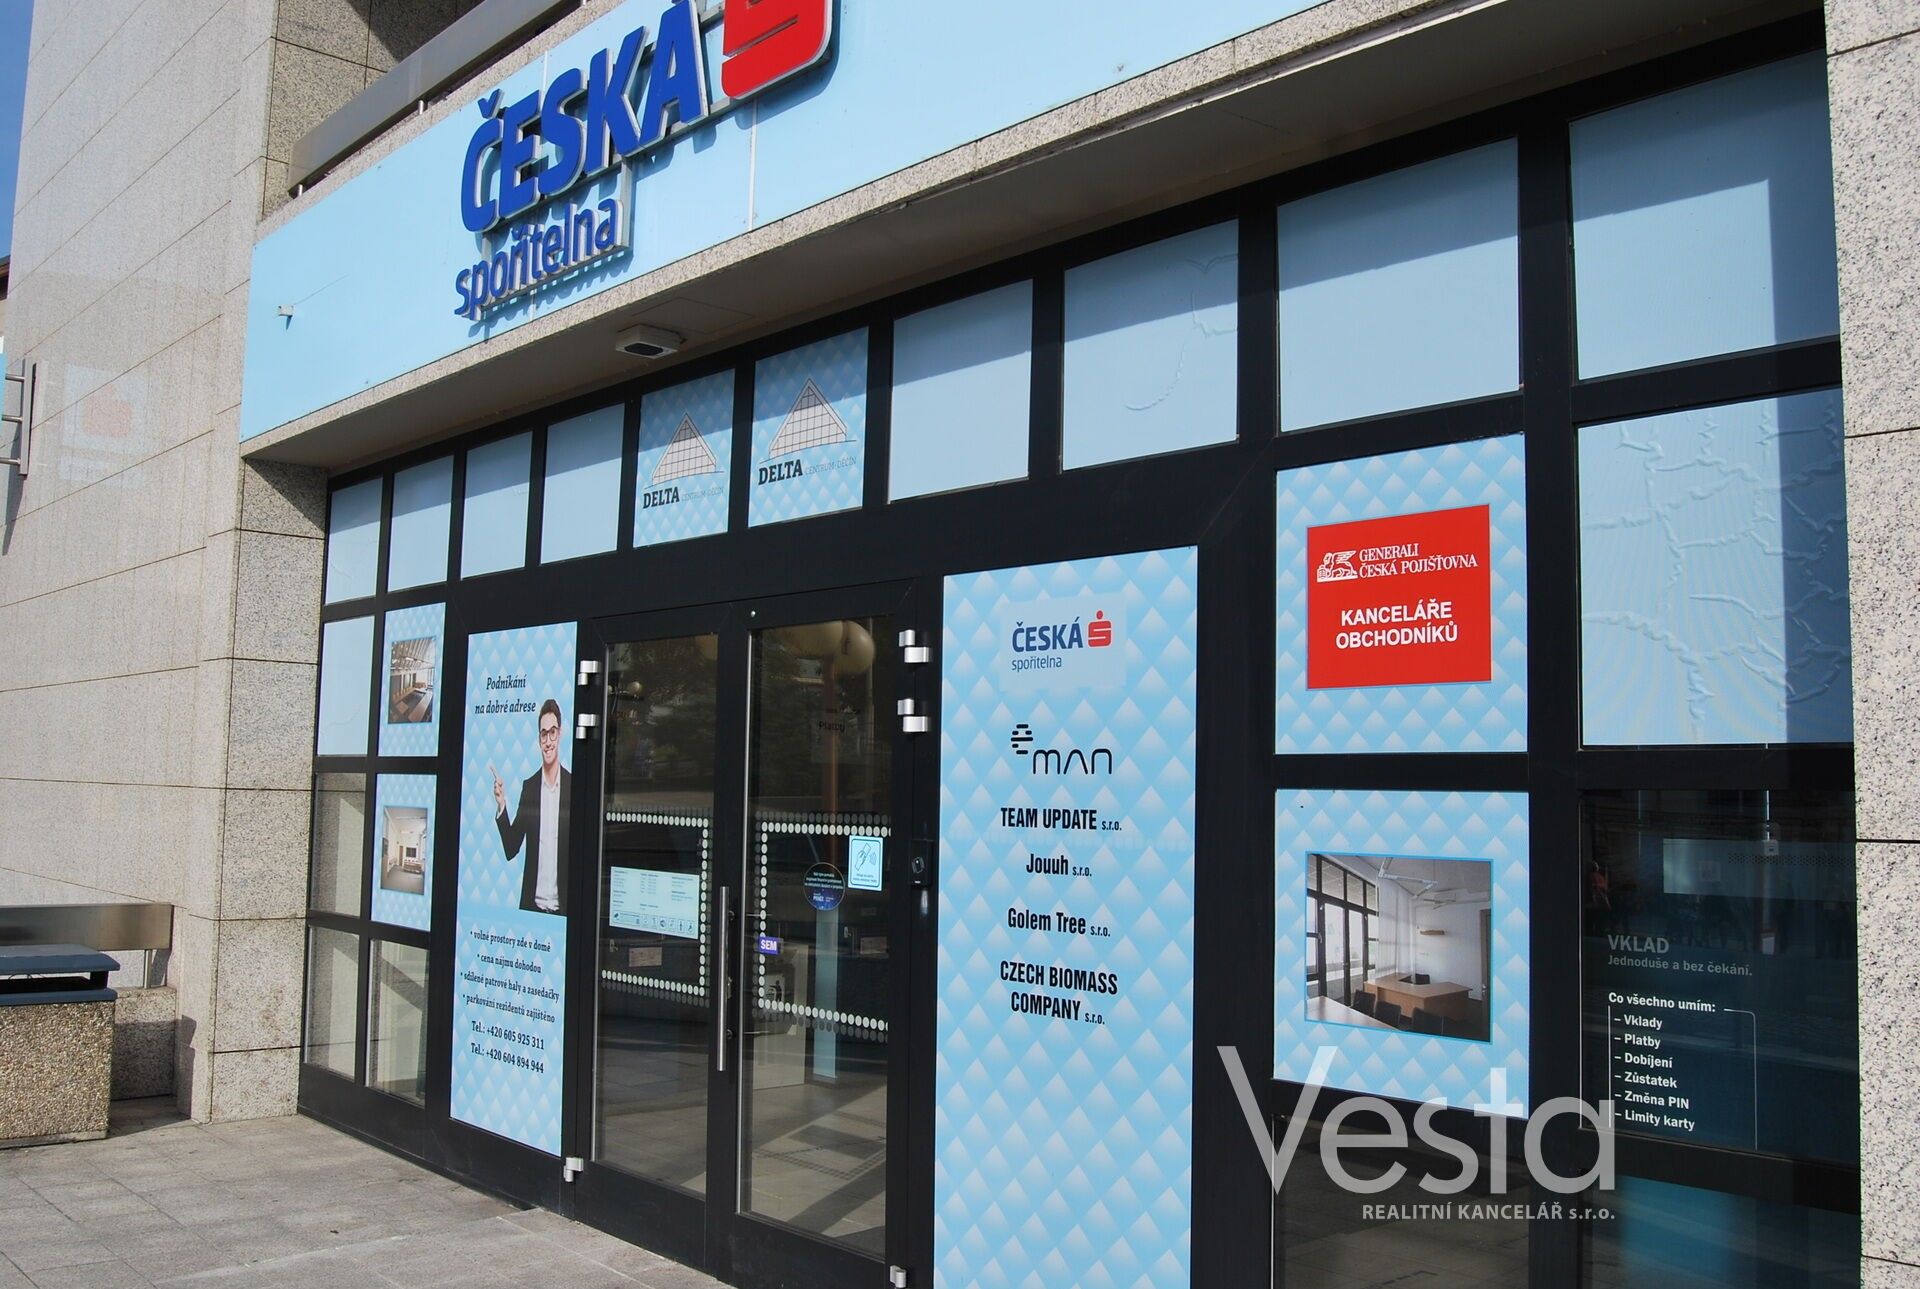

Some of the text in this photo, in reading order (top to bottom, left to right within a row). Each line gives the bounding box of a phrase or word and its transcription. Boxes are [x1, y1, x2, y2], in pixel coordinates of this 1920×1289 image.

[454, 198, 624, 319] spořitelna
[758, 459, 804, 485] DELTA
[642, 486, 680, 509] DELTA
[1359, 543, 1419, 562] GENERALI
[1359, 554, 1479, 578] ČESKÁ POJIŠŤOVNA
[1341, 598, 1452, 627] KANCELÁŘE
[1012, 616, 1083, 652] ČESKÁ
[1336, 621, 1458, 649] OBCHODNÍKŮ
[1011, 655, 1062, 673] spořitelna
[486, 674, 527, 690] Podnikání
[475, 699, 536, 714] na dobré adrese
[1000, 807, 1122, 831] TEAM UPDATE s.r.o.
[1026, 853, 1092, 877] Jouuh s.r.o.
[1007, 907, 1111, 937] Golem Tree s.r.o.
[474, 930, 489, 941] volné
[490, 934, 516, 948] prostory
[516, 937, 529, 948] zde
[533, 939, 551, 952] domě
[760, 939, 777, 951] SEM
[1607, 934, 1670, 954] VKLAD
[480, 954, 541, 973] cena nájmu dohodou
[1607, 955, 1753, 976] Jednoduše a bez čekání.
[464, 971, 484, 983] sdílené
[484, 977, 507, 988] patrové
[508, 979, 521, 994] haly
[527, 986, 560, 1003] zasedačky
[1000, 960, 1118, 995] CZECH BIOMASS
[466, 994, 556, 1023] parkování rezidentů zajištěno
[1011, 991, 1105, 1025] COMPANY s.r.o.
[1608, 992, 1716, 1013] Co všechno umím:
[1623, 1014, 1663, 1031] Vklady
[472, 1021, 545, 1050] Tel.: +420 605 925 311
[1624, 1034, 1661, 1049] Platby
[471, 1042, 544, 1074] Tel.: +420 604 894 944
[1624, 1052, 1673, 1069] Dobíjení
[1624, 1071, 1678, 1089] Zůstatek
[1624, 1090, 1690, 1110] Změna PIN
[1624, 1109, 1695, 1132] Limity karty
